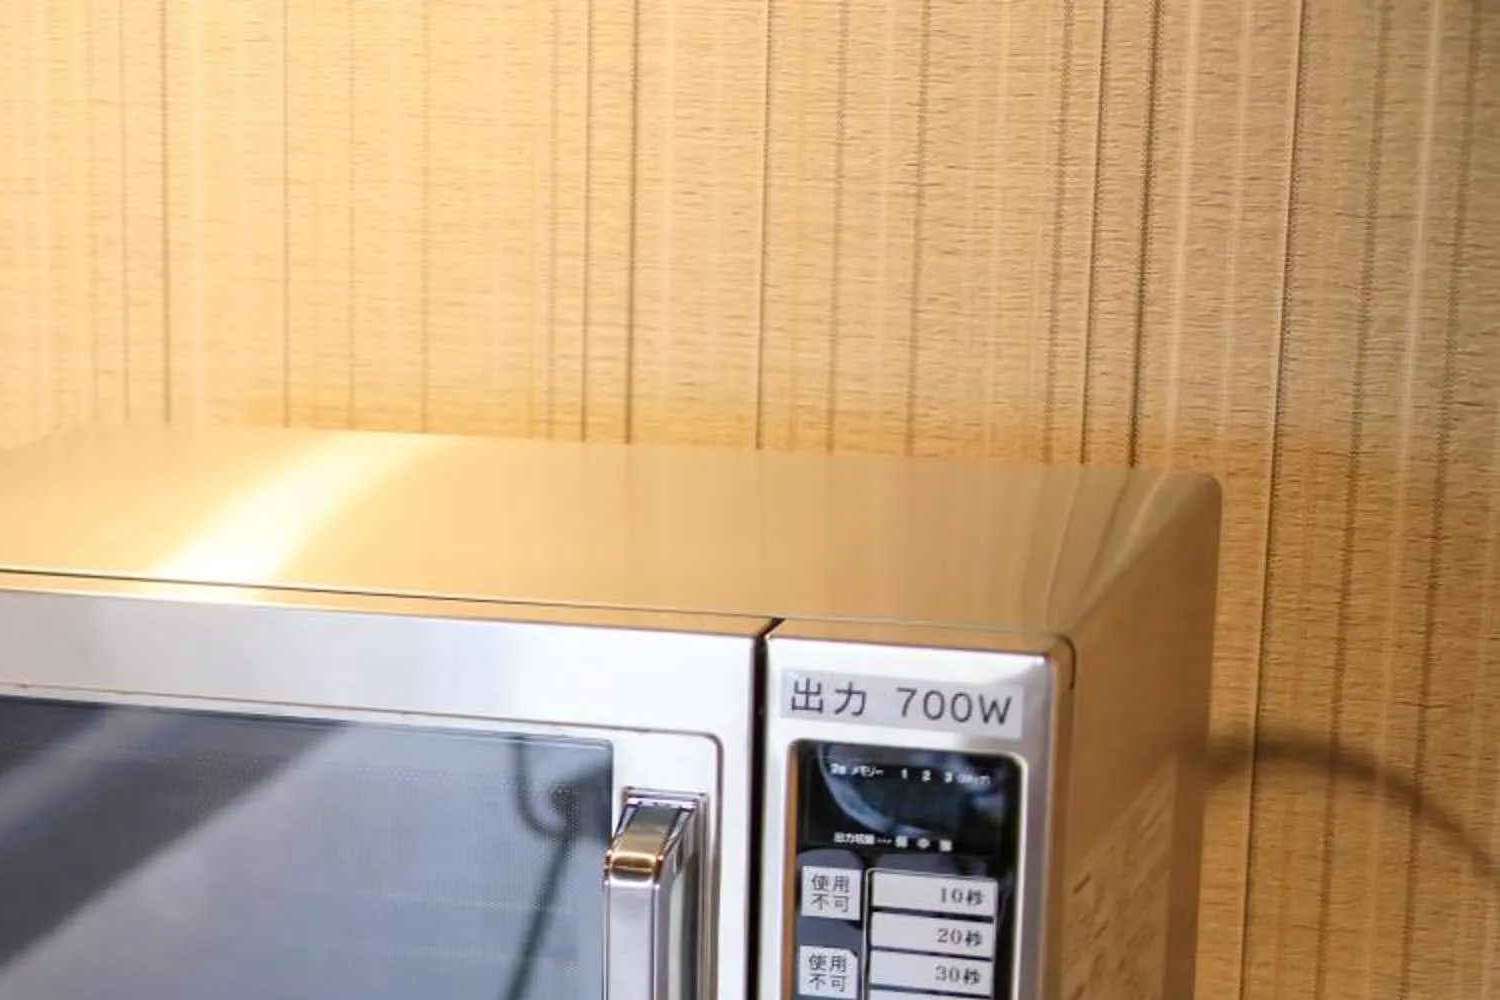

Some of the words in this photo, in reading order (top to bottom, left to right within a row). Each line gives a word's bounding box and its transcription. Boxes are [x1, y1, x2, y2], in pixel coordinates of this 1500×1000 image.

[791, 677, 868, 718] 出力
[896, 686, 1013, 726] 700W
[811, 874, 851, 894] 使用
[811, 893, 851, 914] 不可
[940, 886, 985, 906] 10秒
[936, 927, 983, 947] 20秒
[808, 952, 848, 972] 使用
[807, 973, 847, 993] 不可
[935, 965, 982, 986] 30秒
